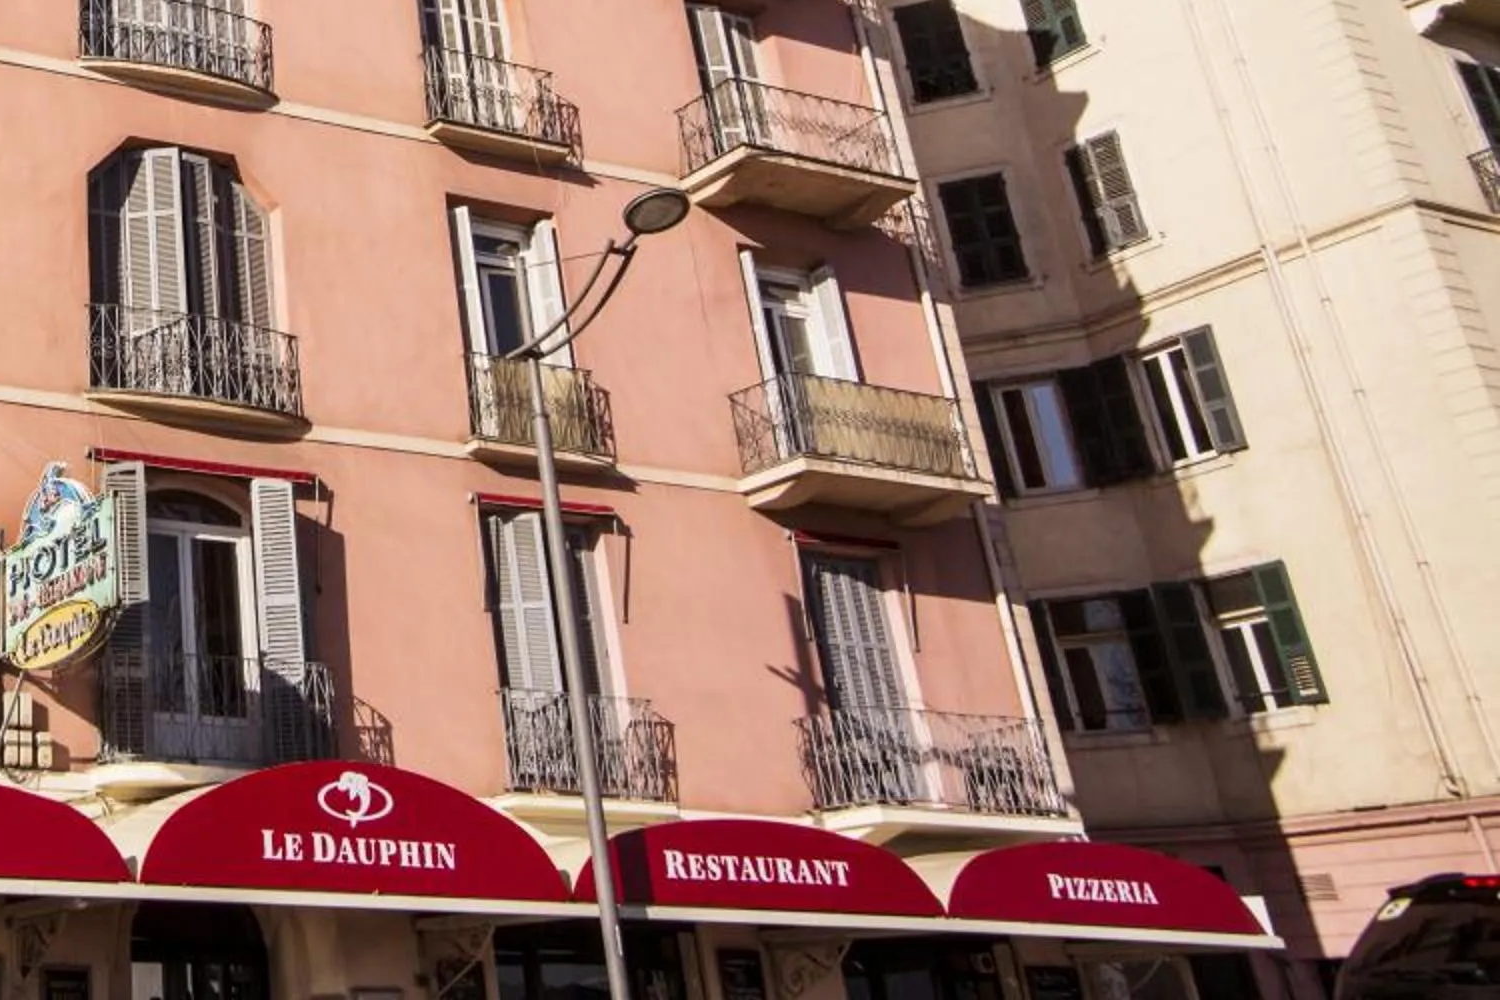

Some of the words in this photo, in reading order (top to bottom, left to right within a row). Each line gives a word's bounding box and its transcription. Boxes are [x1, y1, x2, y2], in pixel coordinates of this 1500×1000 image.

[10, 517, 108, 597] HOTEL
[260, 828, 304, 861] LE
[311, 831, 457, 870] DAUPHIN
[662, 849, 850, 887] RESTAURANT
[1045, 873, 1160, 906] PIZZERIA
